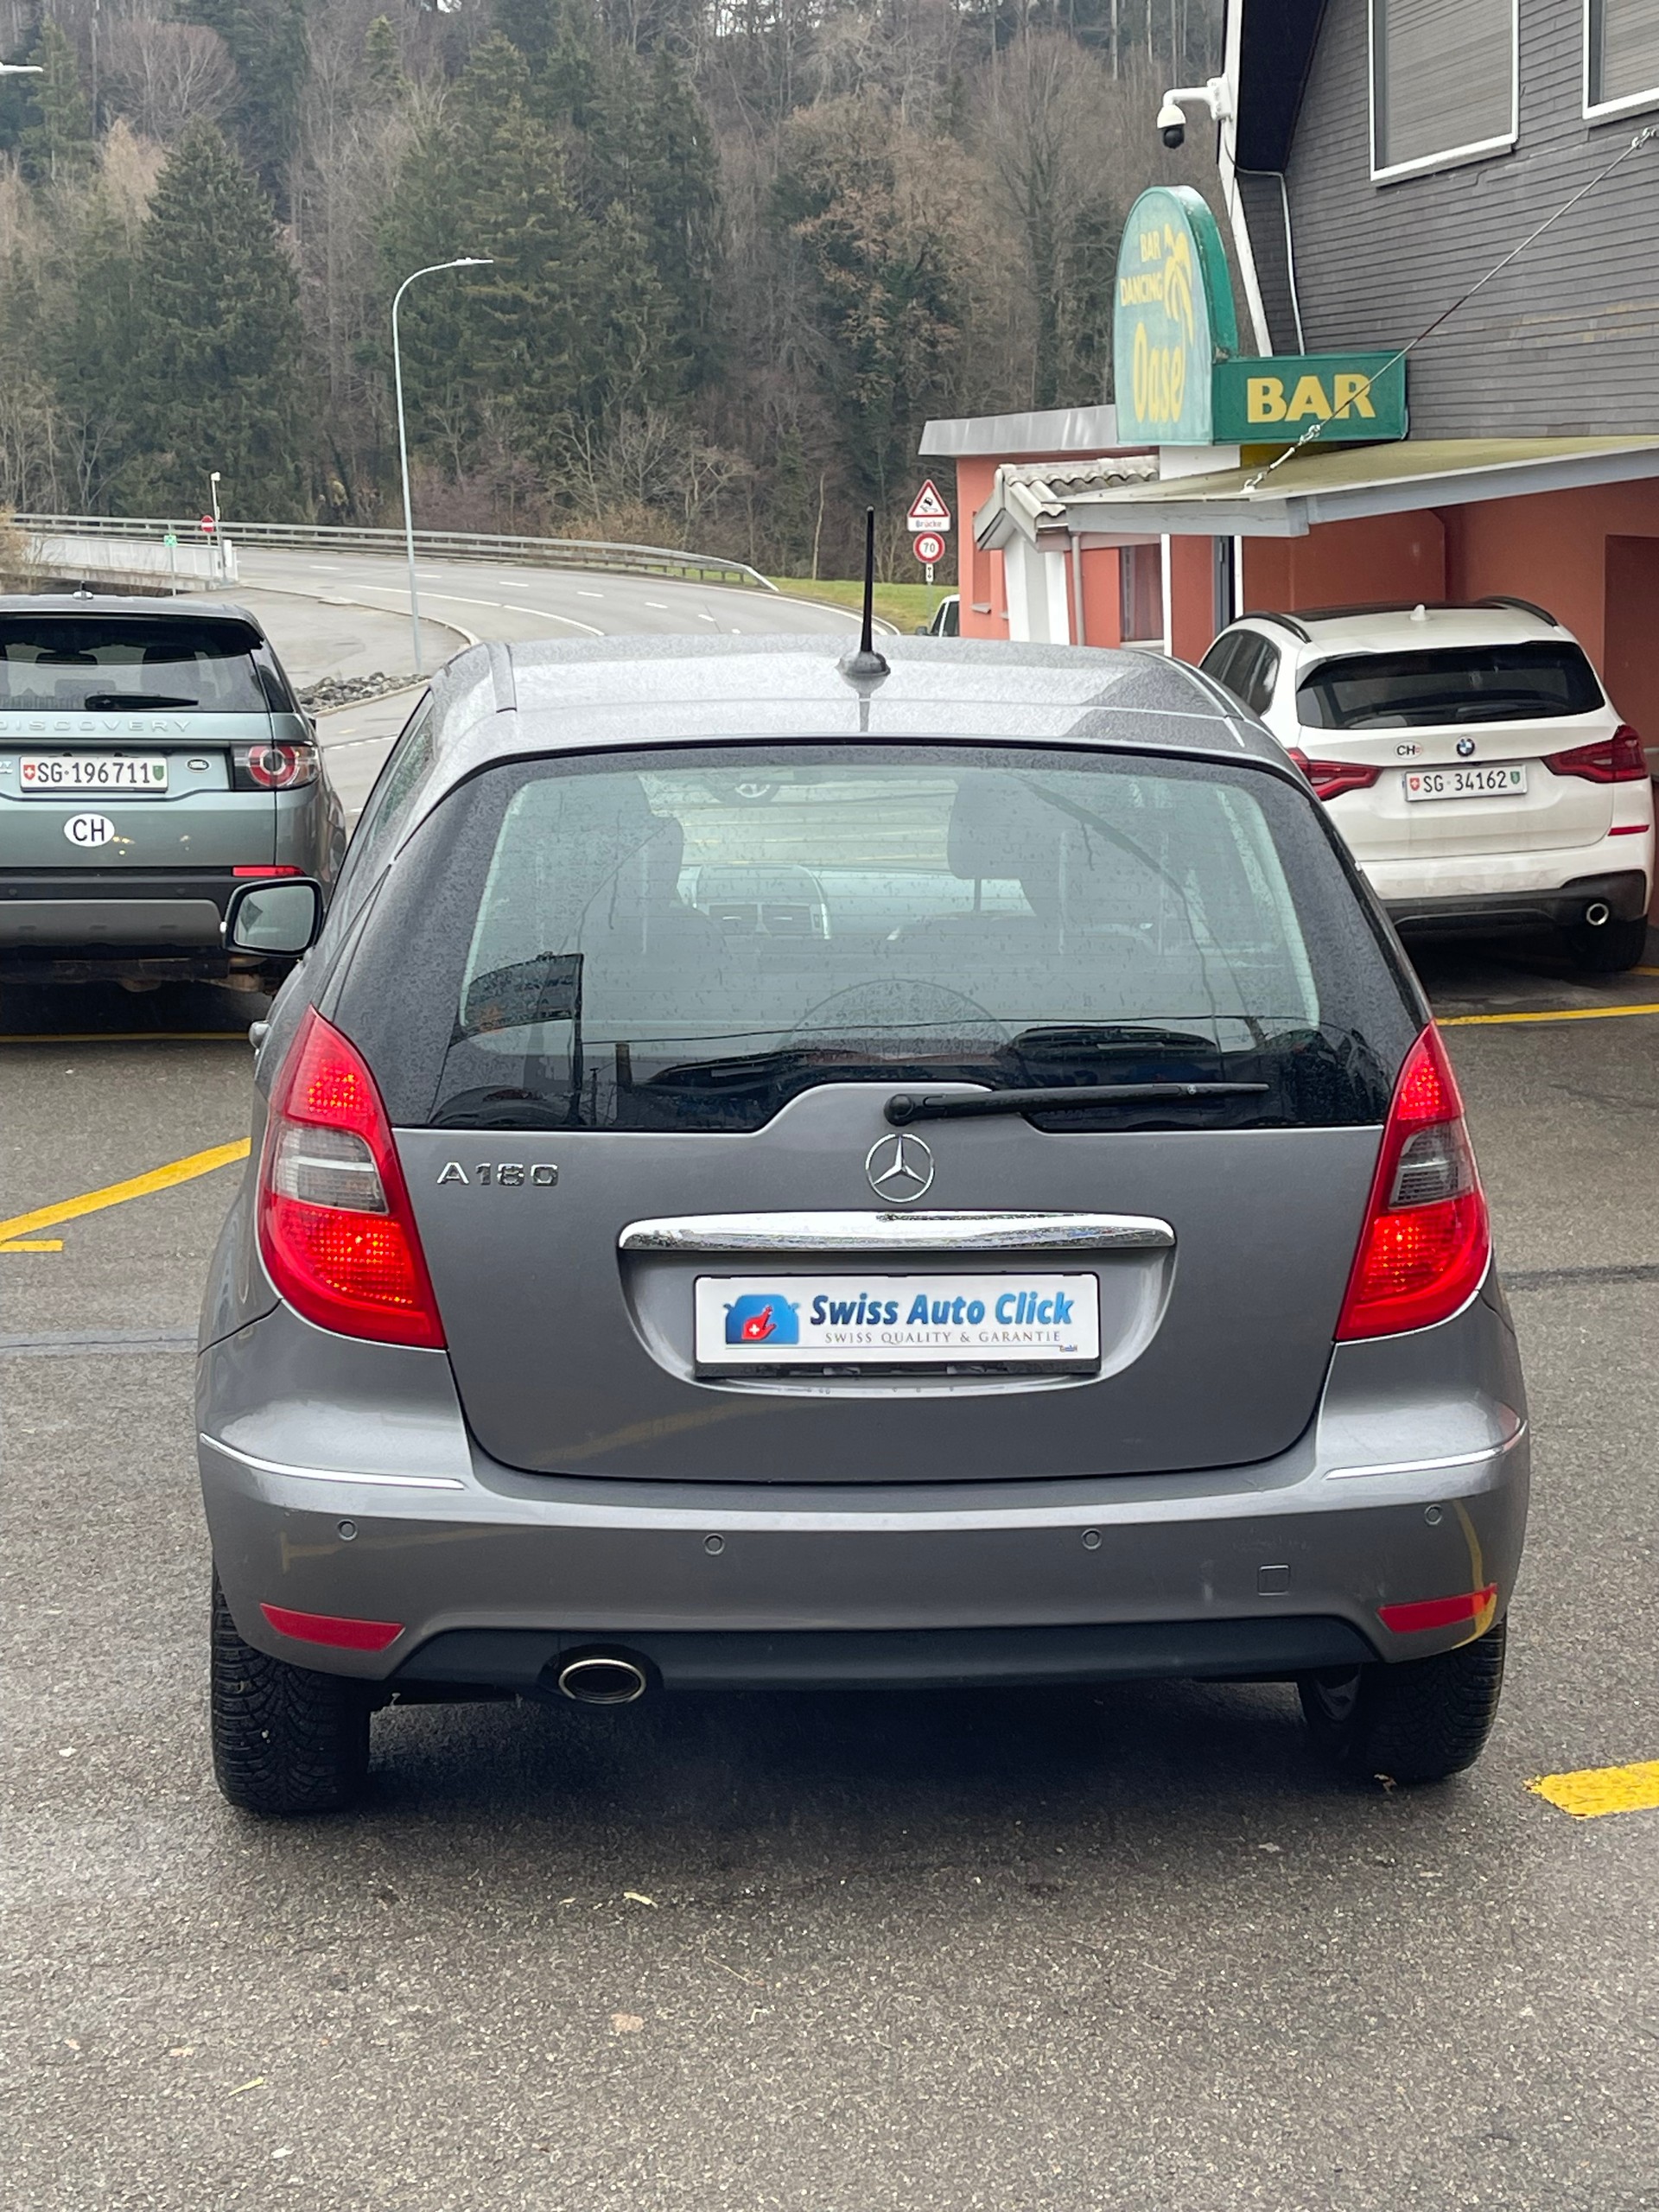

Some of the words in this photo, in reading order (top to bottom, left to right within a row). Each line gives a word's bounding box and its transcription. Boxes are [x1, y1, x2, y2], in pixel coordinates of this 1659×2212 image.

[1140, 230, 1161, 262] BAR
[1120, 271, 1163, 307] DANCING
[1133, 321, 1186, 423] Oase
[1247, 373, 1376, 423] BAR
[924, 542, 936, 553] 70
[1396, 744, 1416, 756] CH
[73, 818, 105, 842] CH
[810, 1293, 899, 1325] Swiss
[906, 1294, 986, 1325] Auto
[995, 1291, 1076, 1325] Click
[825, 1332, 873, 1344] SWISS
[880, 1331, 952, 1345] QUALITY
[959, 1332, 971, 1344] &
[978, 1331, 1061, 1343] GARANTIE
